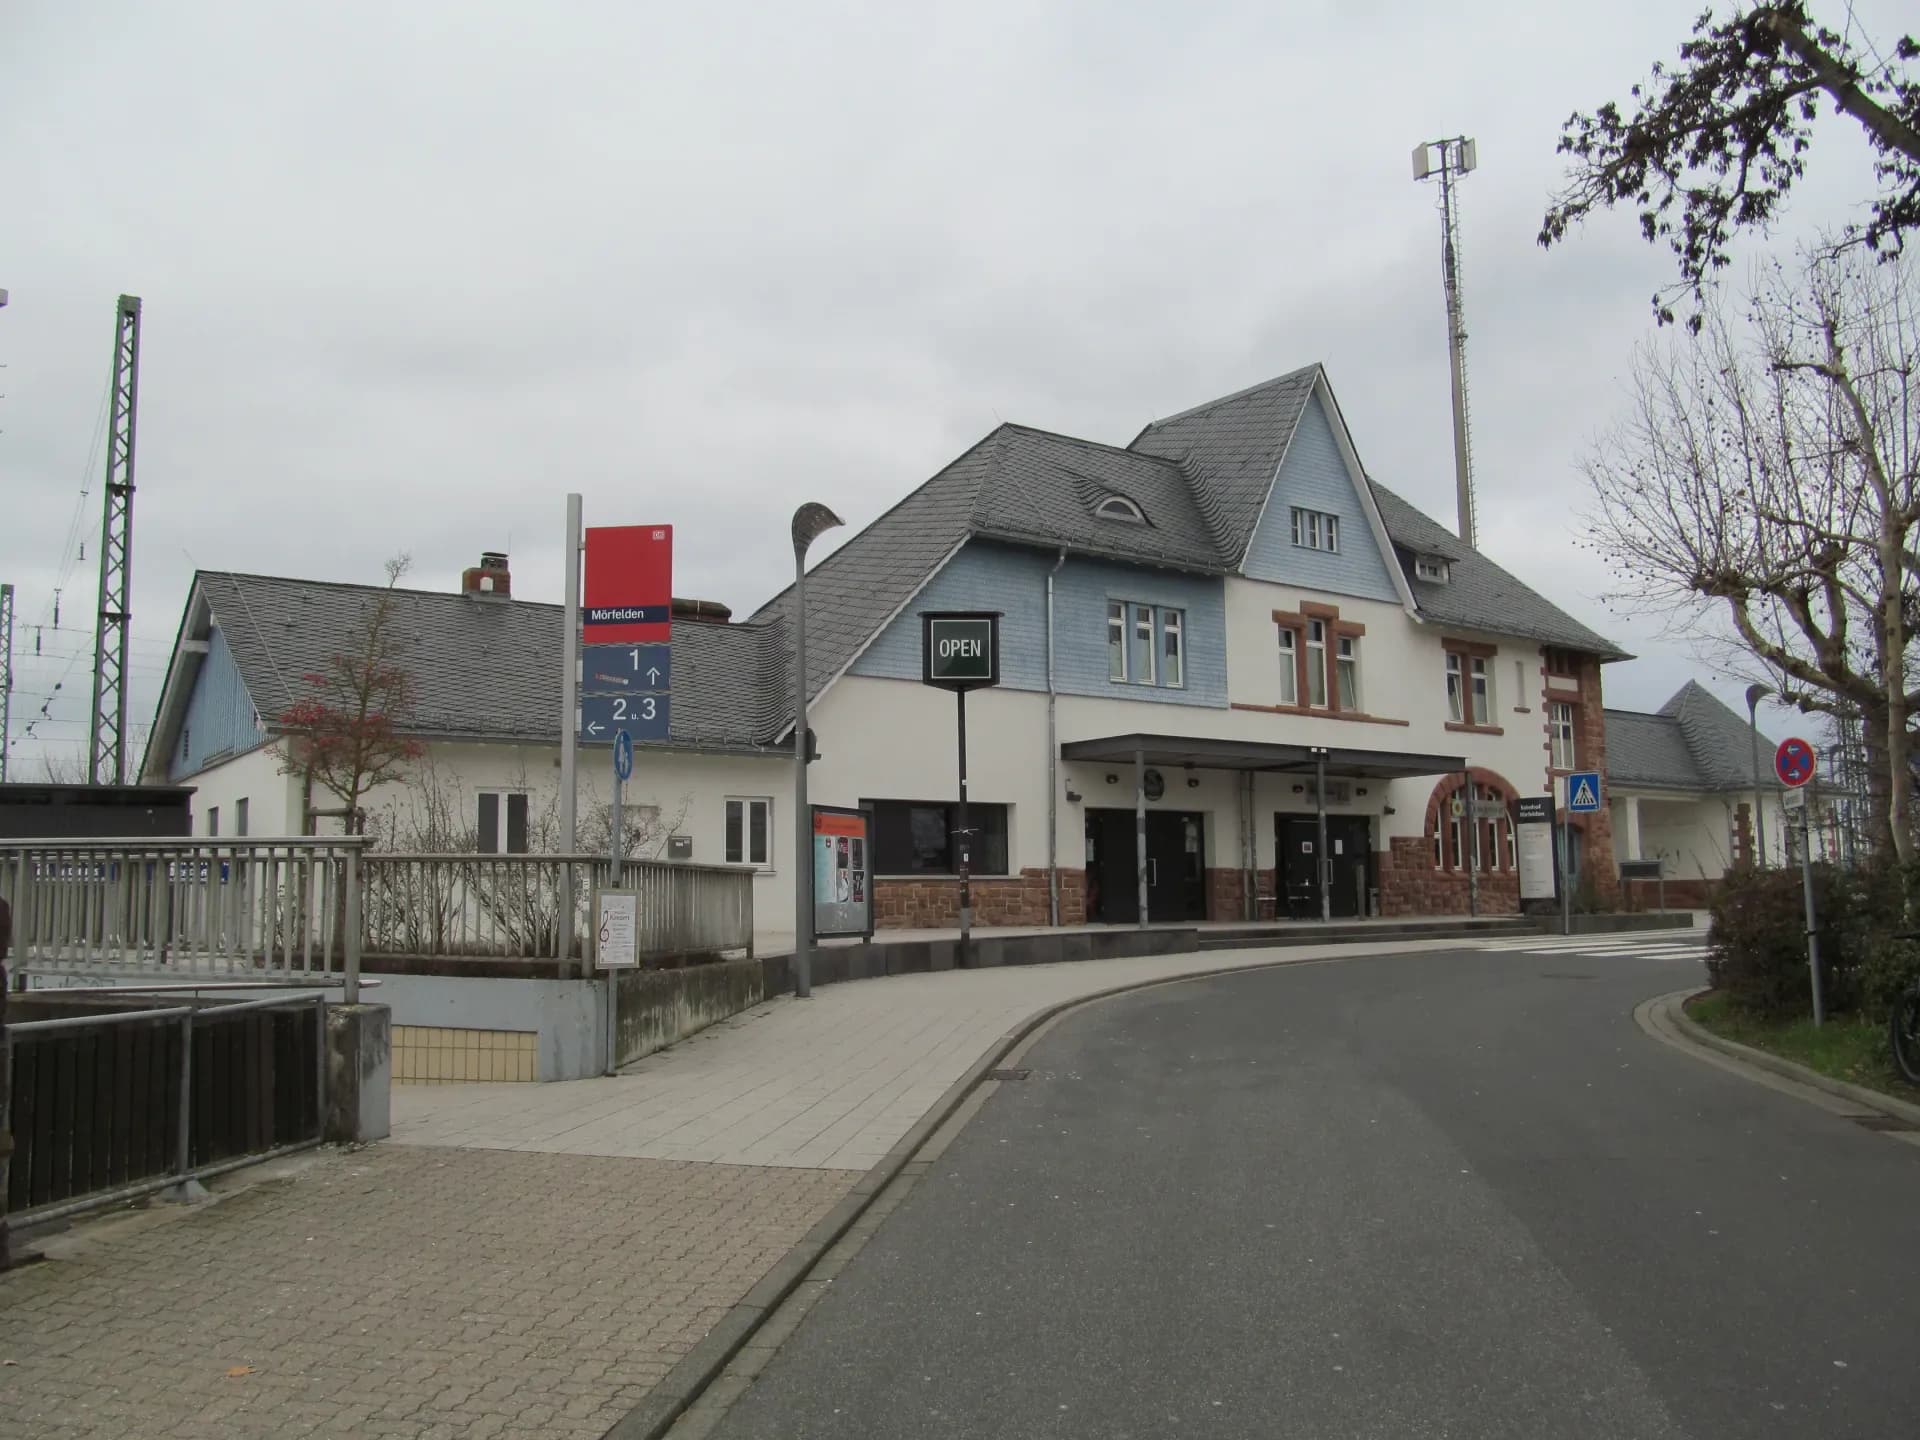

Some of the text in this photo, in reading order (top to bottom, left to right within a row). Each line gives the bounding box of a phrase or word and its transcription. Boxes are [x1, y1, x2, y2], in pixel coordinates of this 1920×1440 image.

[591, 608, 644, 621] Mörfelden
[939, 639, 981, 657] OPEN
[629, 649, 639, 671] 1
[613, 697, 657, 721] 2 u. 3
